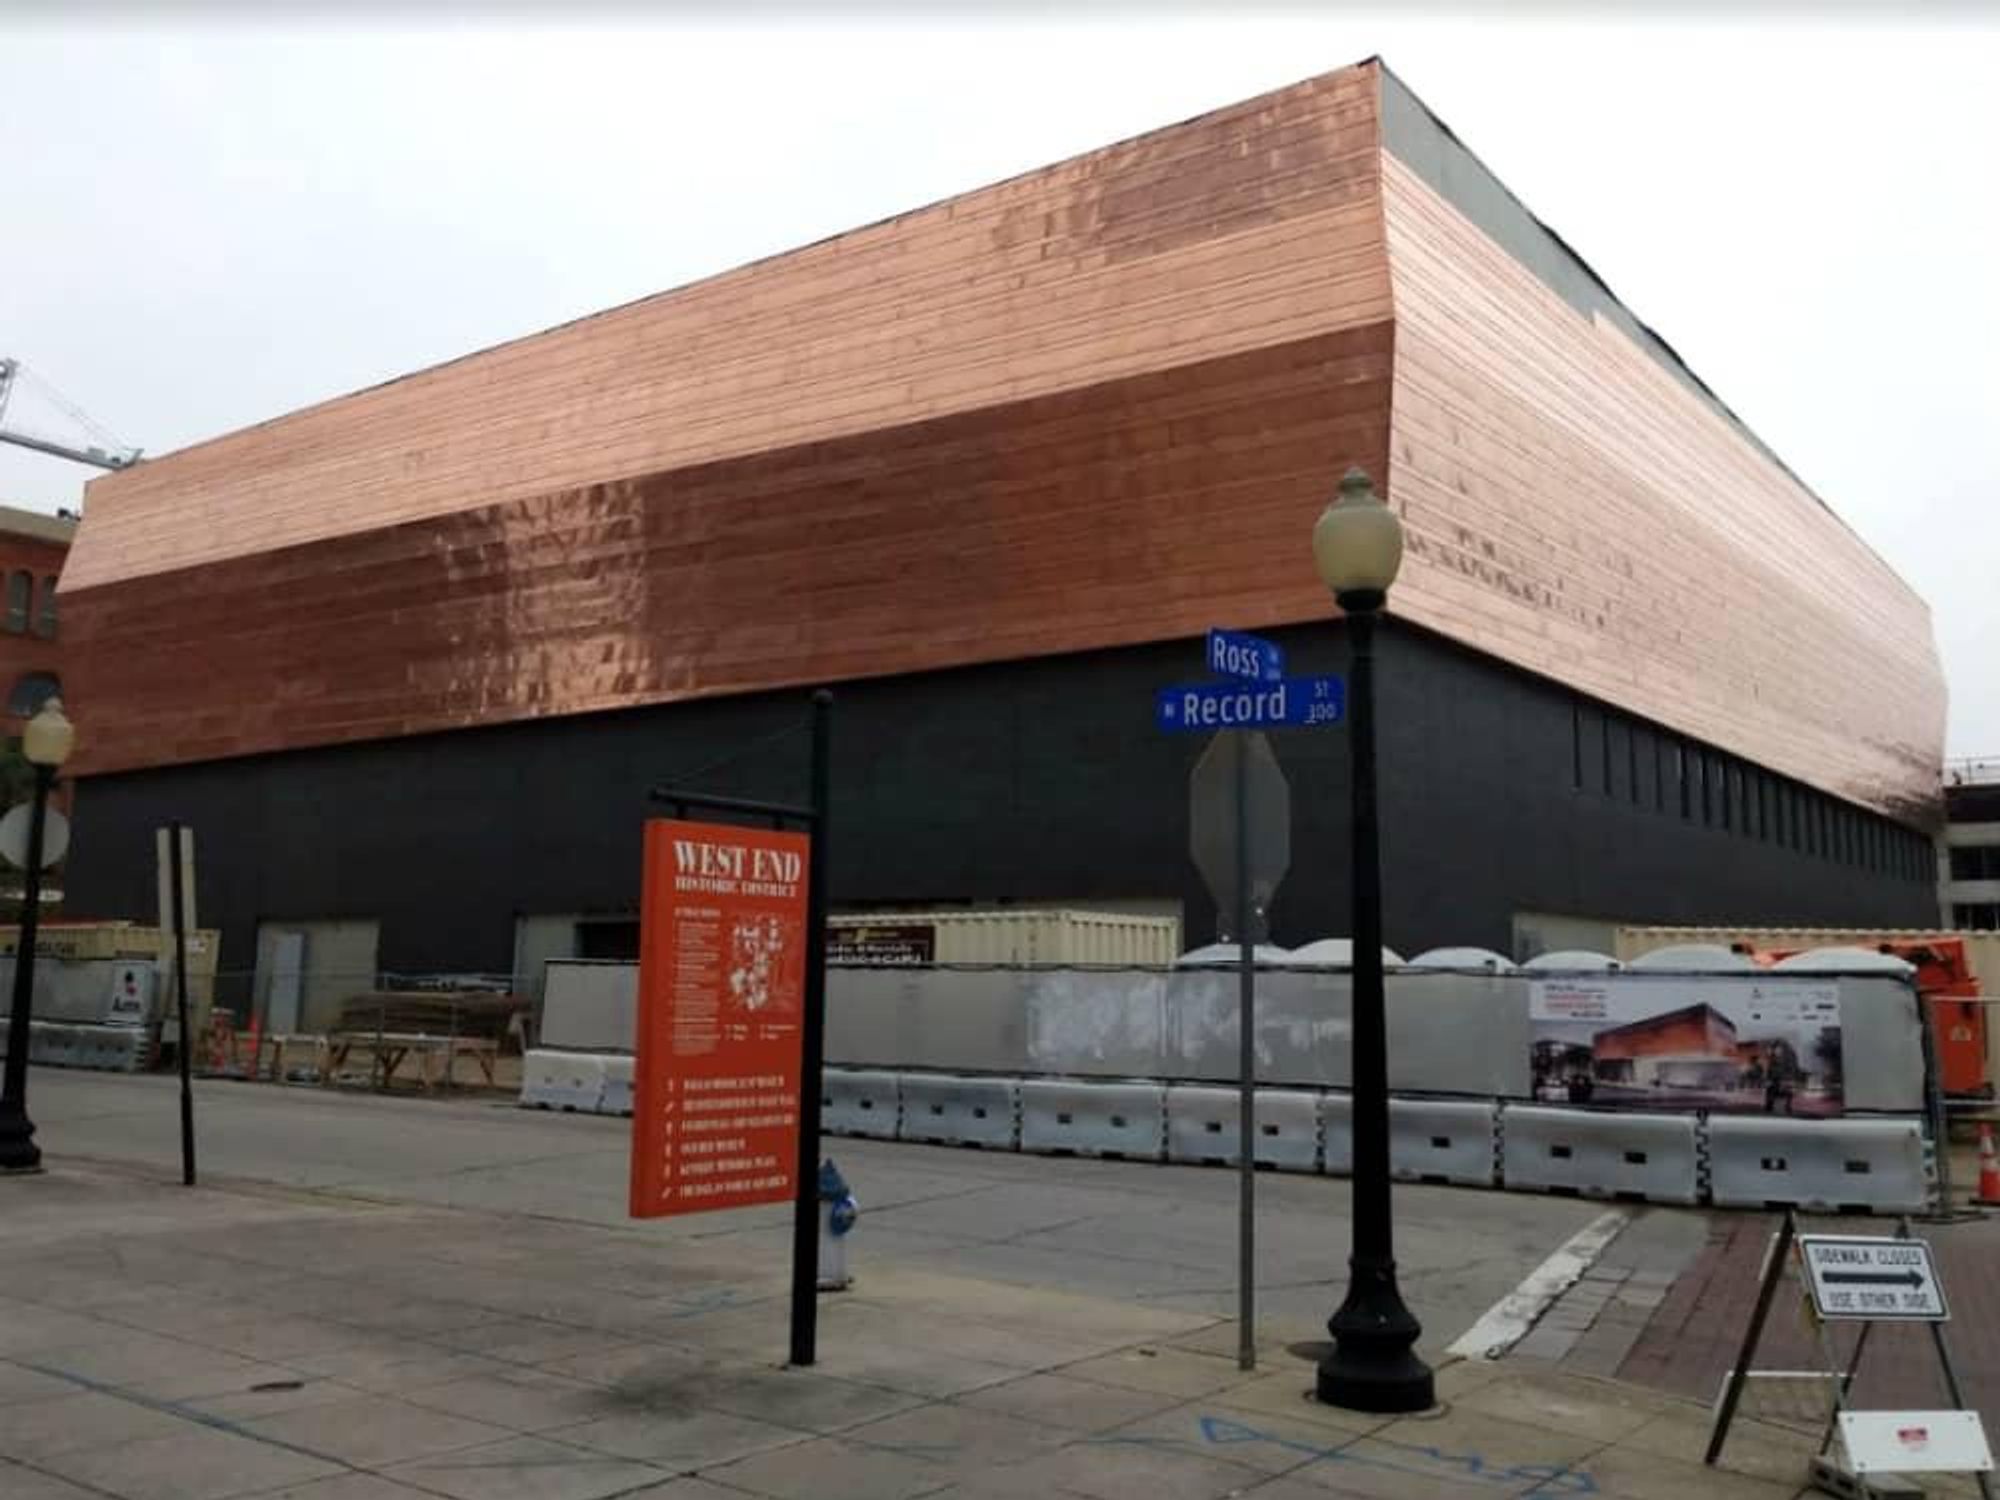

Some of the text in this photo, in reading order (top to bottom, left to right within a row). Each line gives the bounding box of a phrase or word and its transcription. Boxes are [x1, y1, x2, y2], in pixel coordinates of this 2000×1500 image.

[1213, 636, 1260, 678] Ross
[1183, 684, 1286, 725] Record
[674, 840, 800, 883] WEST END
